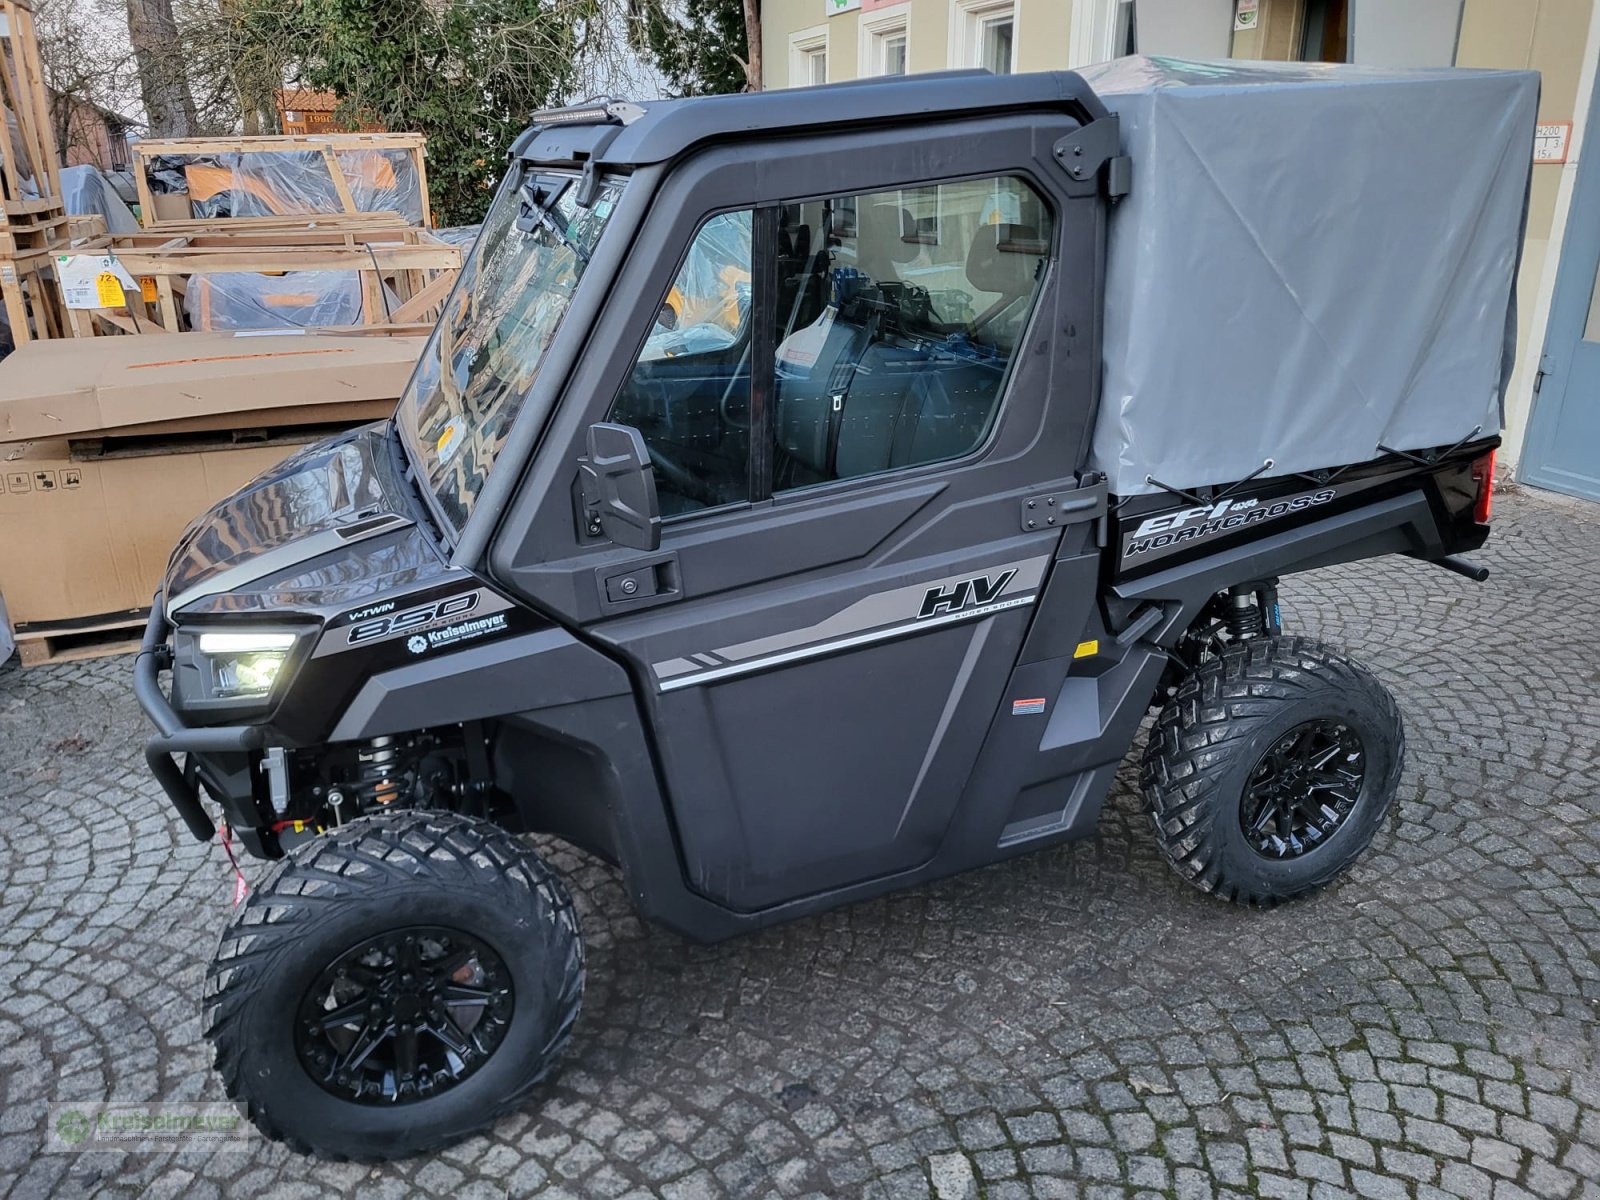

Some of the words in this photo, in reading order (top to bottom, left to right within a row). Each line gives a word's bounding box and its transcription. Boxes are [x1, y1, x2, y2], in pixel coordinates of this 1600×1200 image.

[1123, 489, 1336, 558] WORKCROSS
[1132, 499, 1234, 540] EFI
[350, 602, 395, 621] V-TWIN
[916, 568, 1019, 619] HV
[346, 590, 481, 646] 850
[427, 613, 505, 642] Kreiselmeyer
